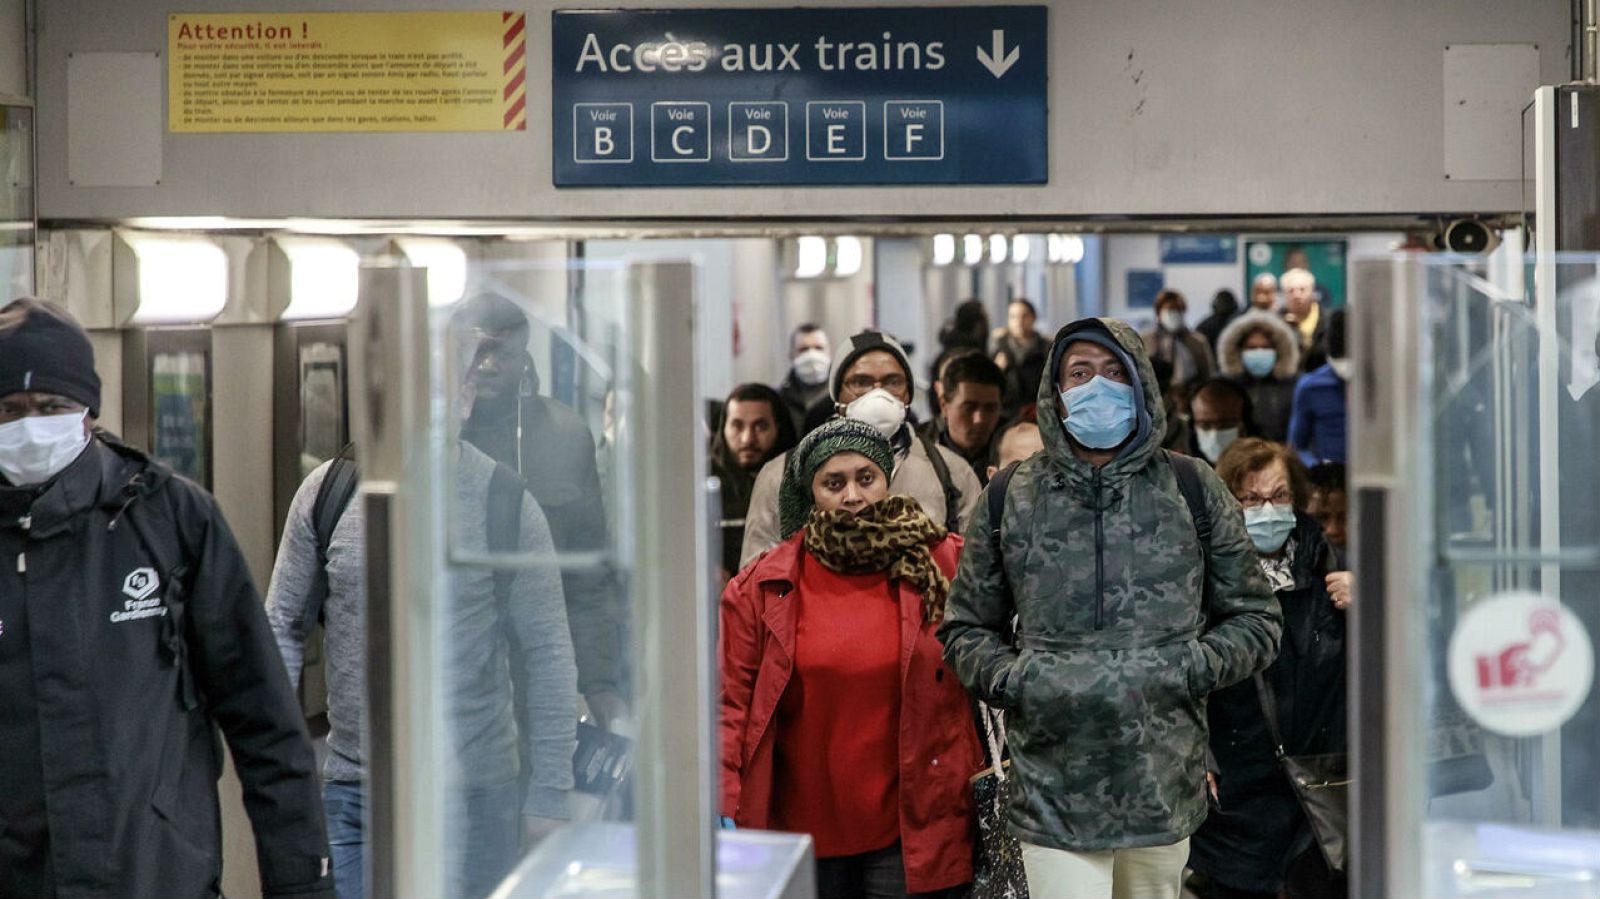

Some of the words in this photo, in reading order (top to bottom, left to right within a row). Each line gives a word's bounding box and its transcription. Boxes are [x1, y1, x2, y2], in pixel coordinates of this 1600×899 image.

[178, 22, 292, 40] Attention
[302, 21, 308, 39] !
[575, 32, 707, 73] Accès
[721, 41, 800, 73] aux
[816, 31, 945, 71] trains
[590, 108, 617, 122] Voie
[668, 107, 694, 121] Voie
[745, 107, 771, 121] Voie
[822, 106, 849, 120] Voie
[900, 106, 926, 120] Voie
[594, 126, 615, 154] B
[671, 125, 695, 155] C
[747, 125, 771, 153] D
[827, 125, 846, 153] E
[906, 124, 923, 152] F
